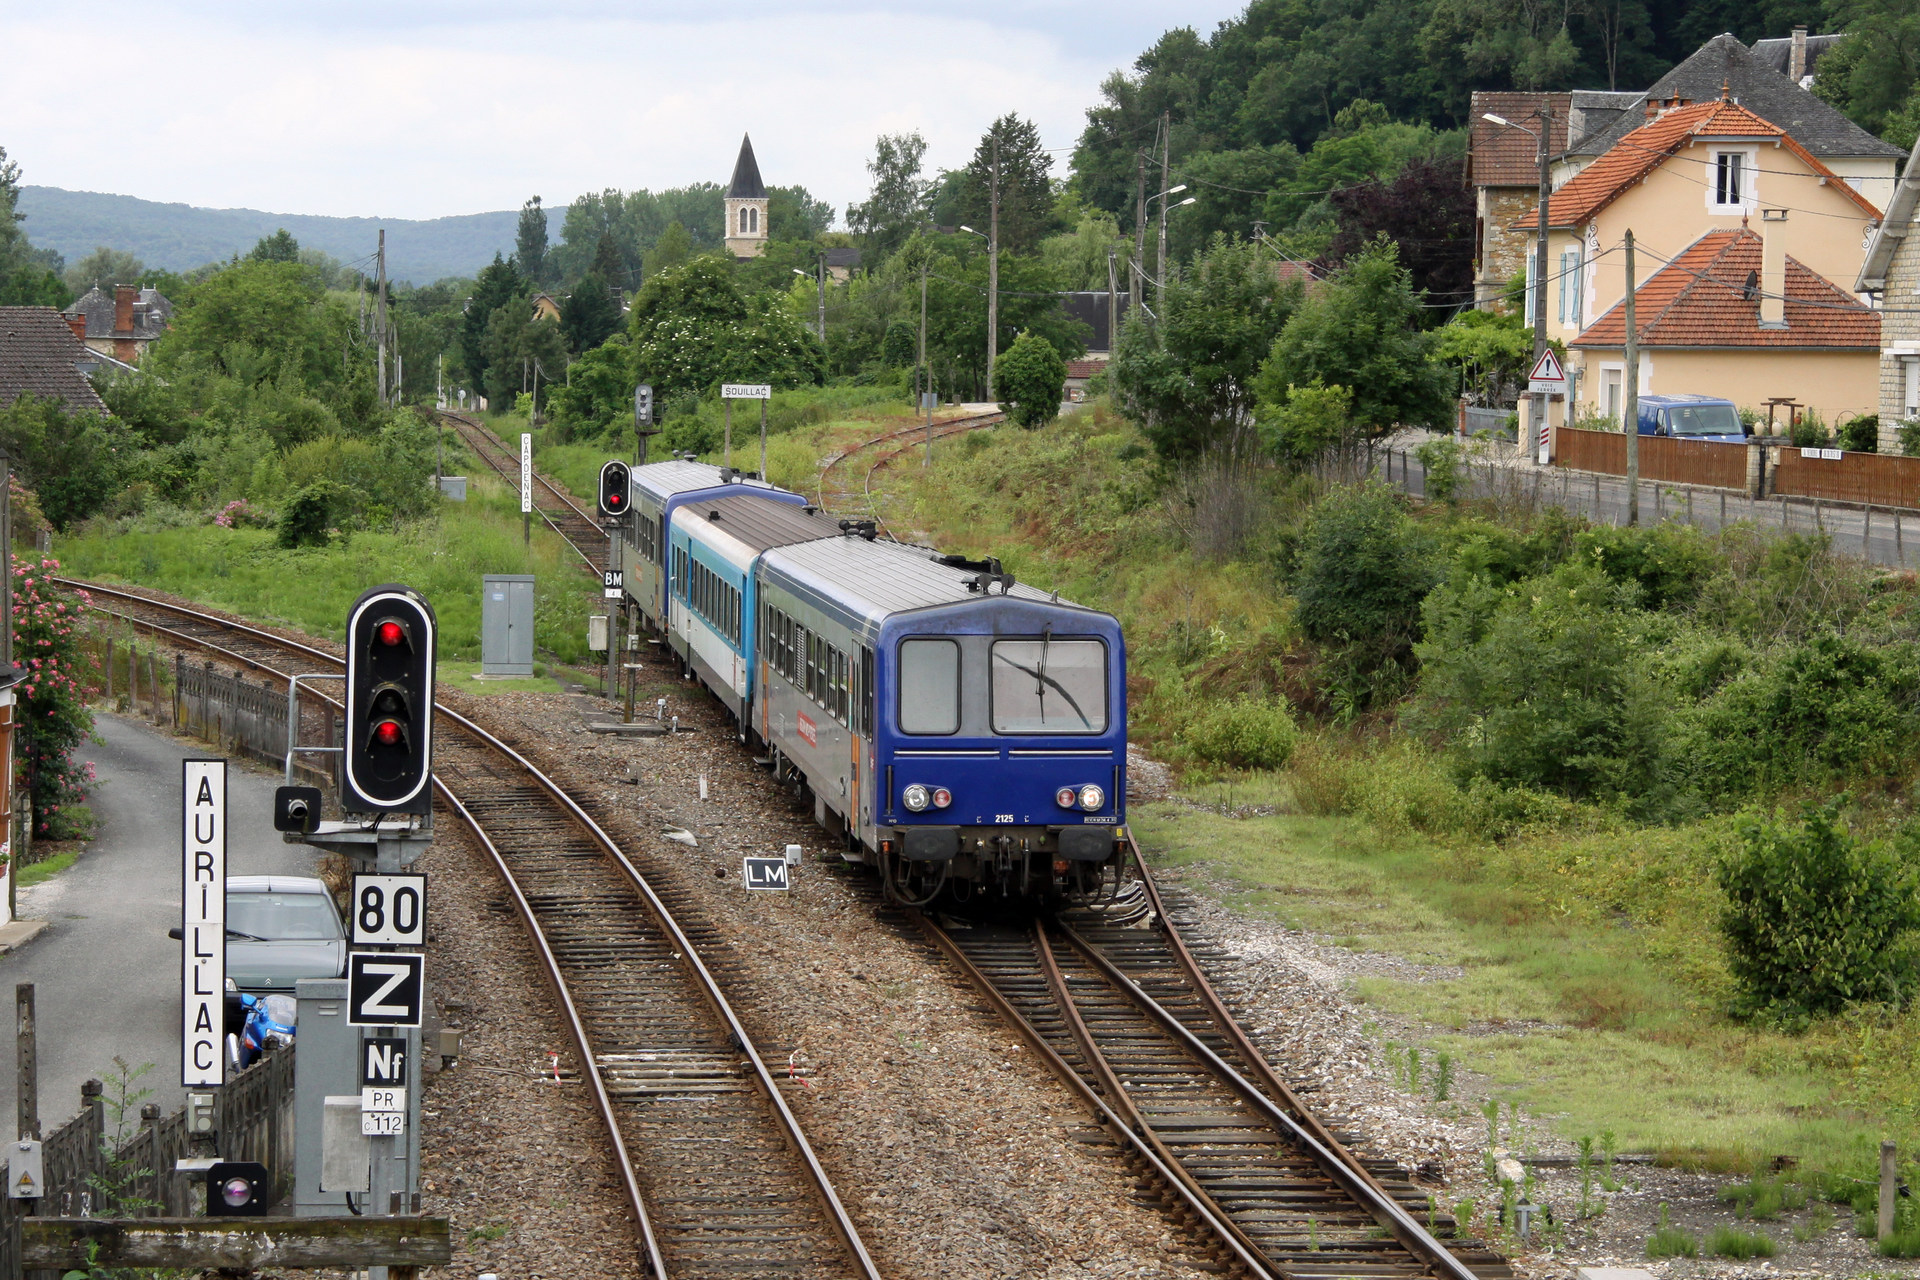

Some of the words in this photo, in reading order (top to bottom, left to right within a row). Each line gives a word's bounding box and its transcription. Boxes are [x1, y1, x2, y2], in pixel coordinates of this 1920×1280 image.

[725, 387, 767, 396] SOUILLAC
[605, 572, 622, 586] BM
[995, 815, 1014, 823] 2125
[748, 865, 784, 882] LM
[359, 886, 419, 934] 80
[194, 776, 214, 1071] AURILLAC
[361, 964, 410, 1016] Z
[368, 1045, 404, 1079] Nf
[373, 1093, 394, 1106] PR
